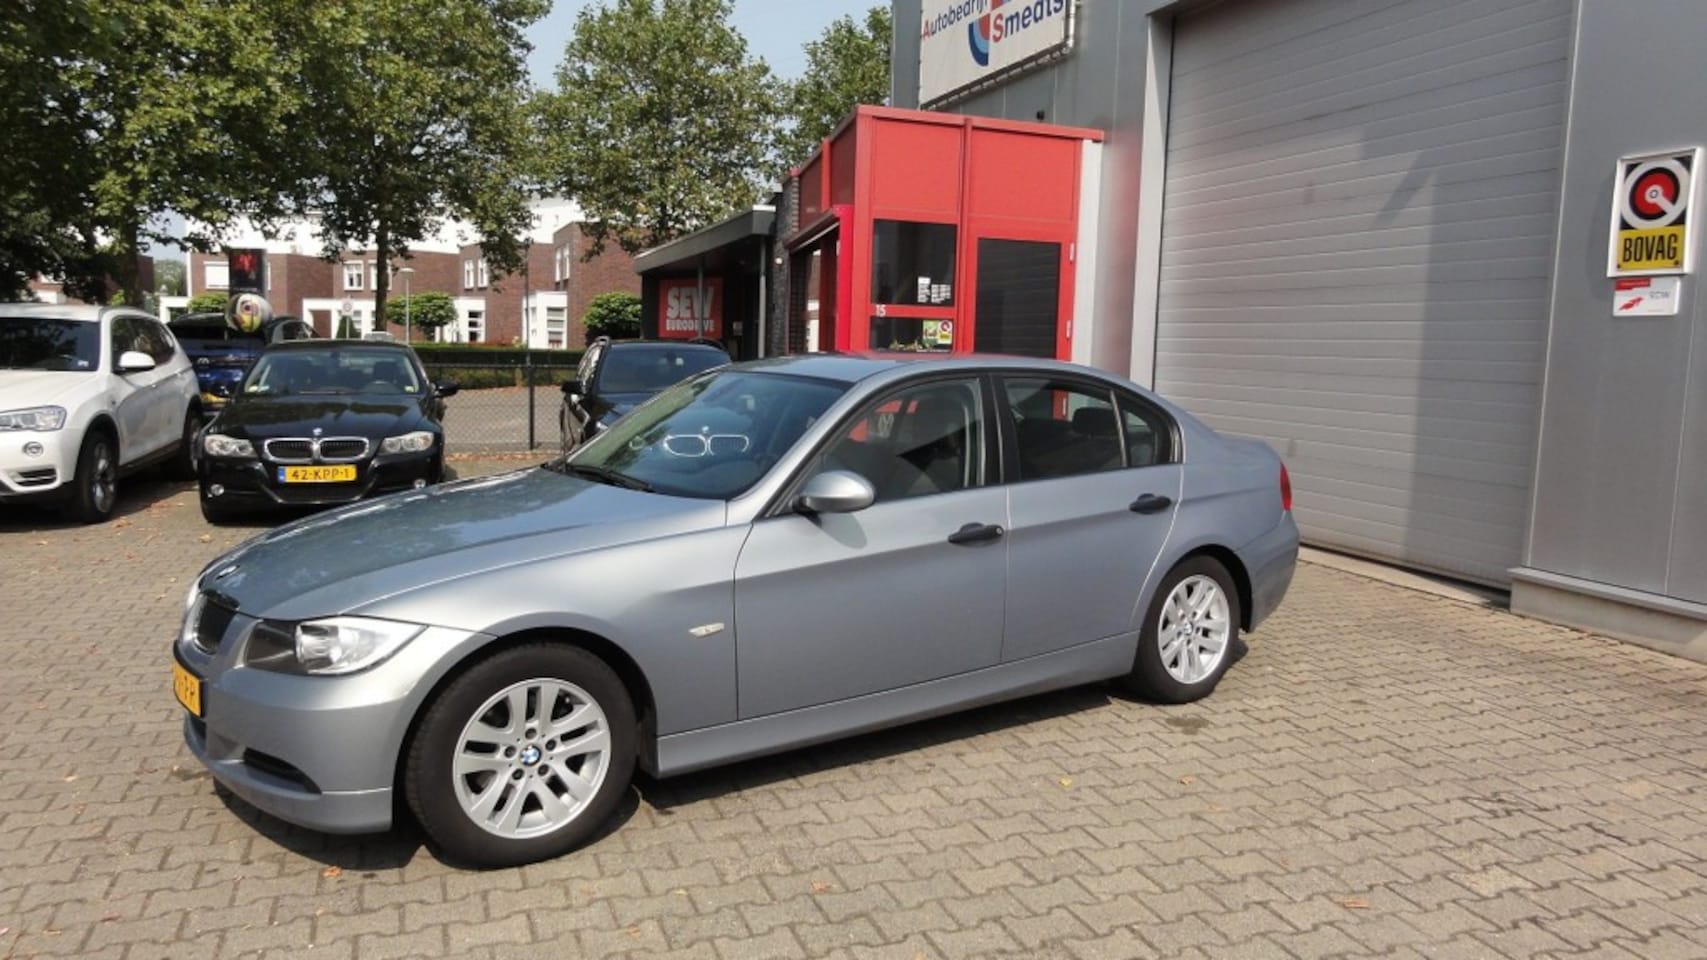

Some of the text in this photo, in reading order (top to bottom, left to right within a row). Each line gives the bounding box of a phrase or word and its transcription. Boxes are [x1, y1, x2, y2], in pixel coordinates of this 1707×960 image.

[1622, 233, 1678, 263] BOVAG
[666, 286, 714, 319] SEW
[876, 304, 886, 317] 15
[666, 319, 715, 332] EURODRVE
[291, 468, 350, 480] 42-KPP-1
